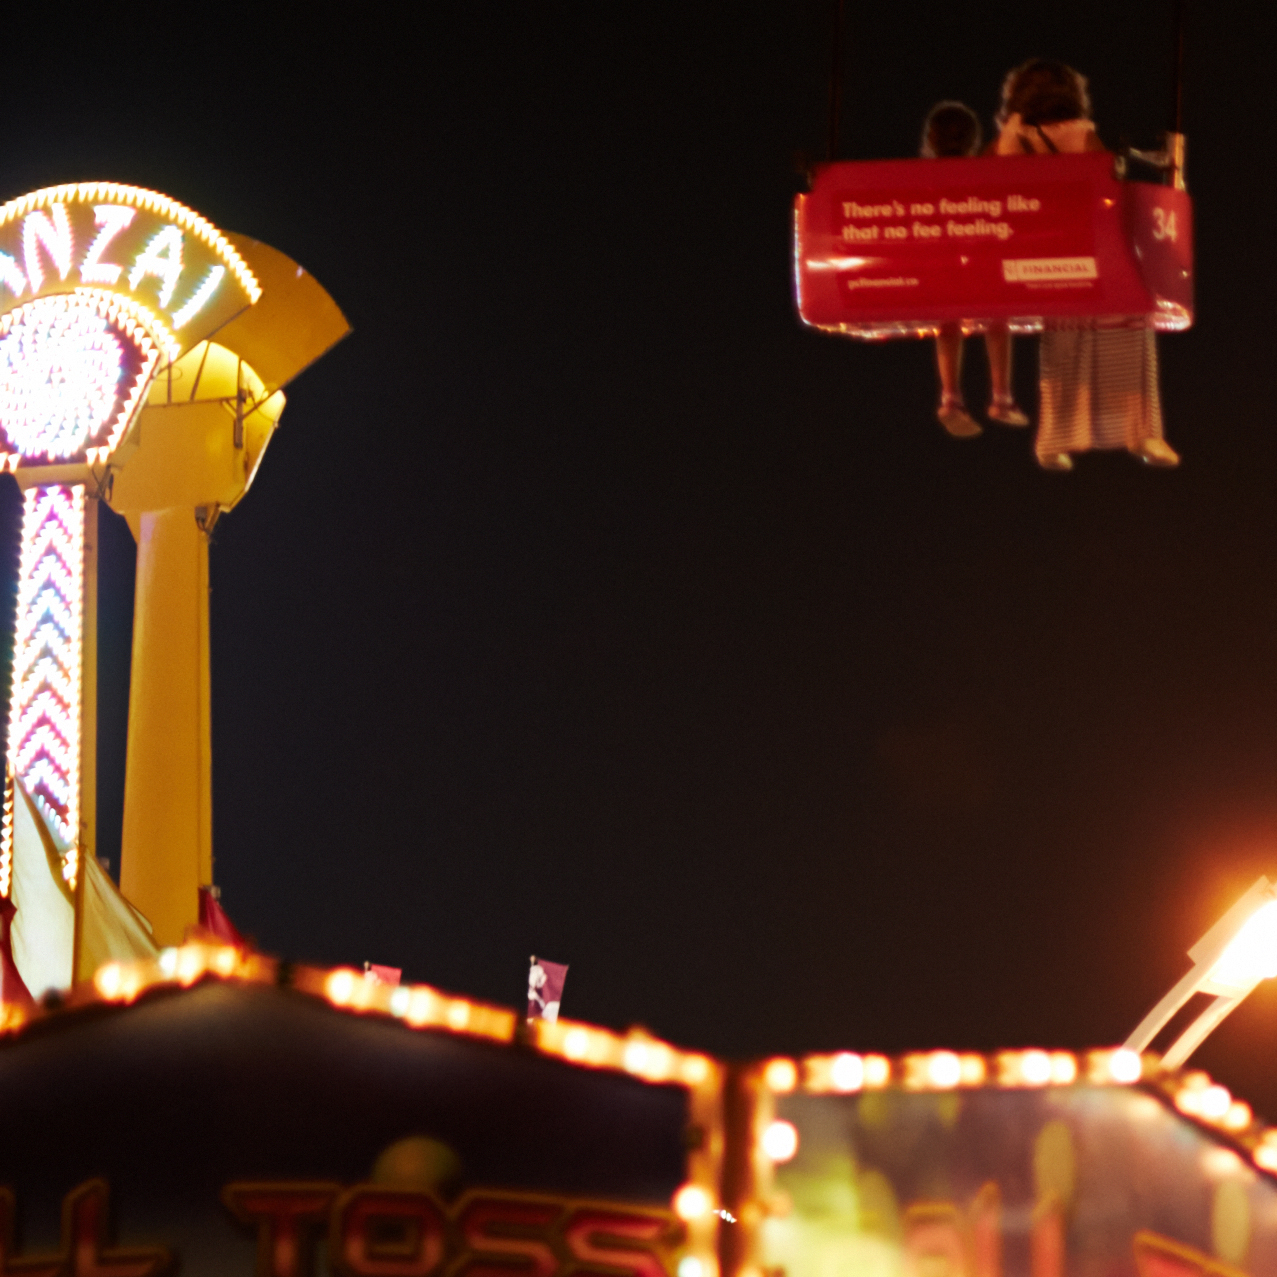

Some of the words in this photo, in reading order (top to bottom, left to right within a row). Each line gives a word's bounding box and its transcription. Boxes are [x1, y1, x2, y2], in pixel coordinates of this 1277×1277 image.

[843, 200, 905, 219] There's
[910, 203, 934, 216] no
[940, 197, 1001, 218] feeling
[1007, 195, 1041, 213] like
[843, 224, 878, 241] that
[884, 225, 908, 240] no
[912, 221, 942, 239] fee
[946, 218, 1014, 241] feeling.
[1152, 206, 1177, 243] 34
[1022, 263, 1089, 275] FINANCIAL
